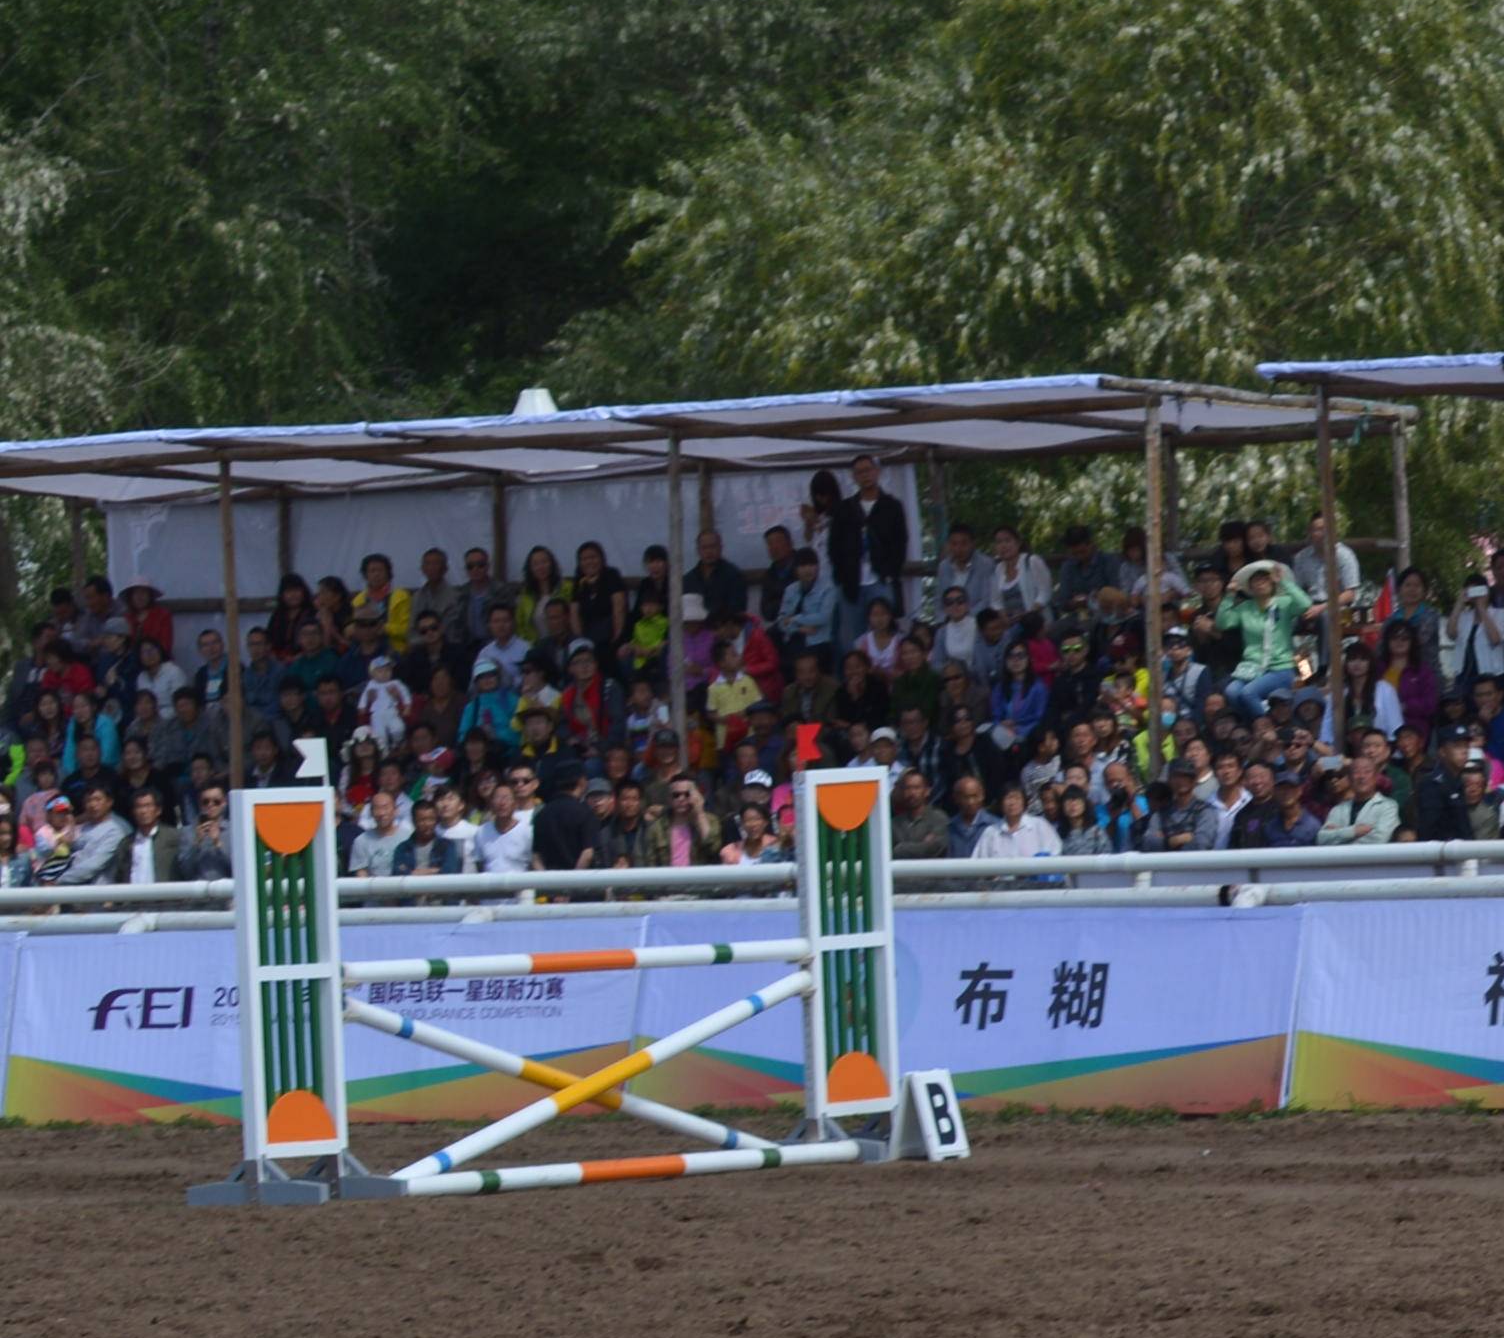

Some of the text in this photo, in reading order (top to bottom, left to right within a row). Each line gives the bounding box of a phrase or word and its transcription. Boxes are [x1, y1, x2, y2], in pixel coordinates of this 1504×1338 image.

[88, 986, 195, 1030] FEI
[955, 961, 1109, 1031] 布 糊
[926, 1083, 957, 1145] B
